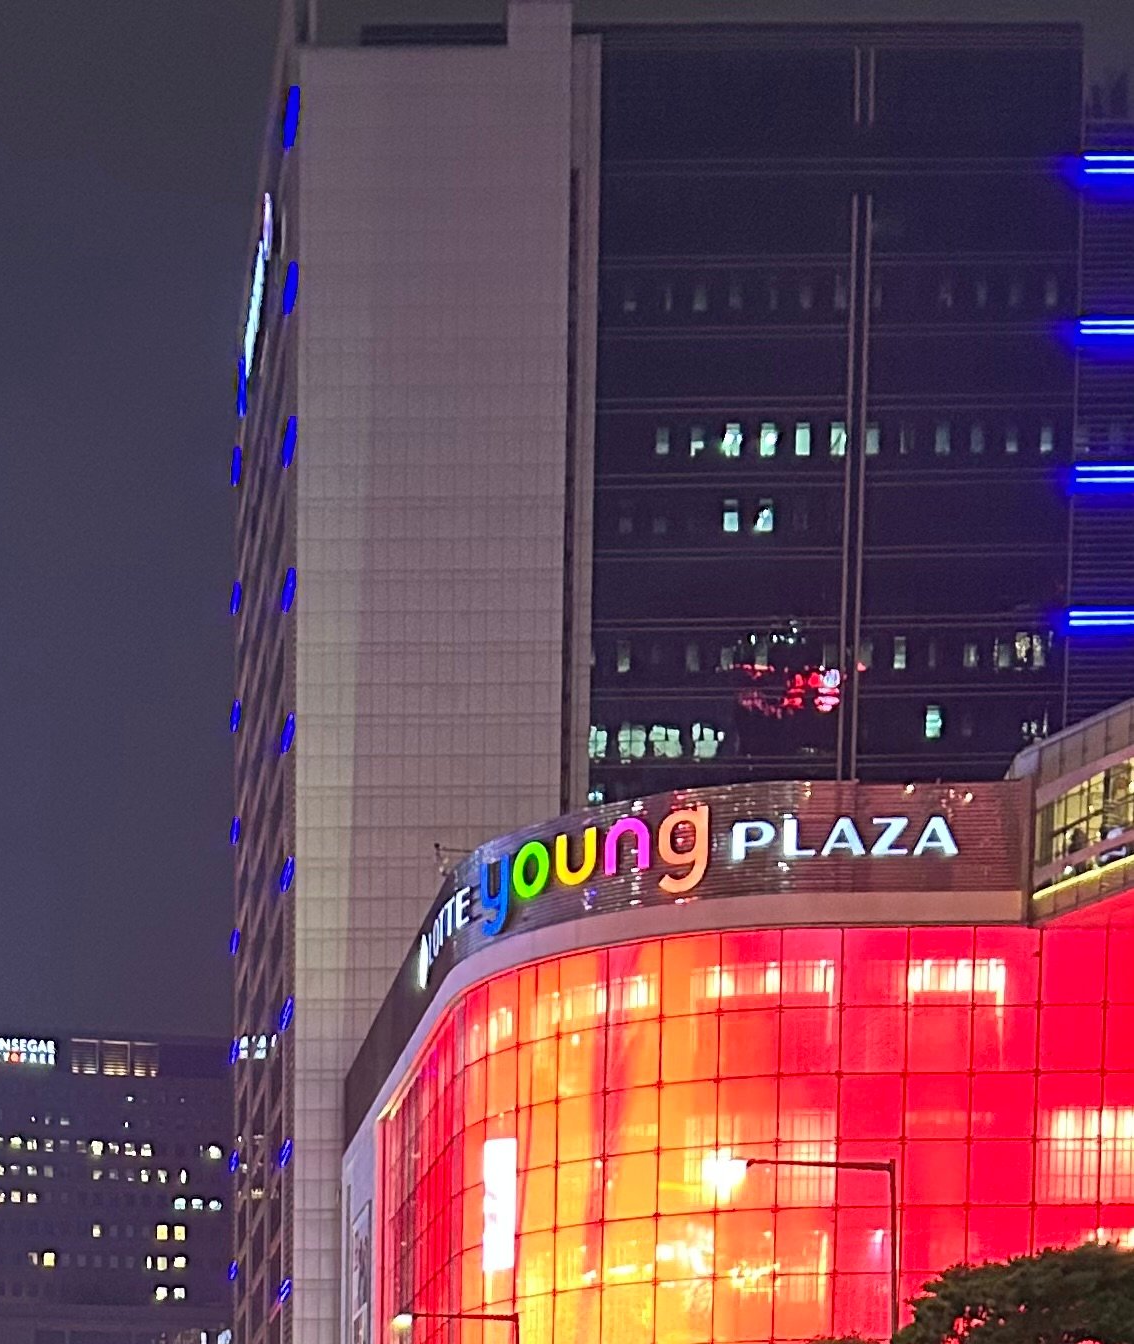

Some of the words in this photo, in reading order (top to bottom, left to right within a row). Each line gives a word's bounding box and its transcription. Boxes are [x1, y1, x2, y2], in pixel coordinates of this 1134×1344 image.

[426, 886, 471, 966] LOTTE
[479, 804, 709, 936] young
[731, 815, 959, 861] PLAZA
